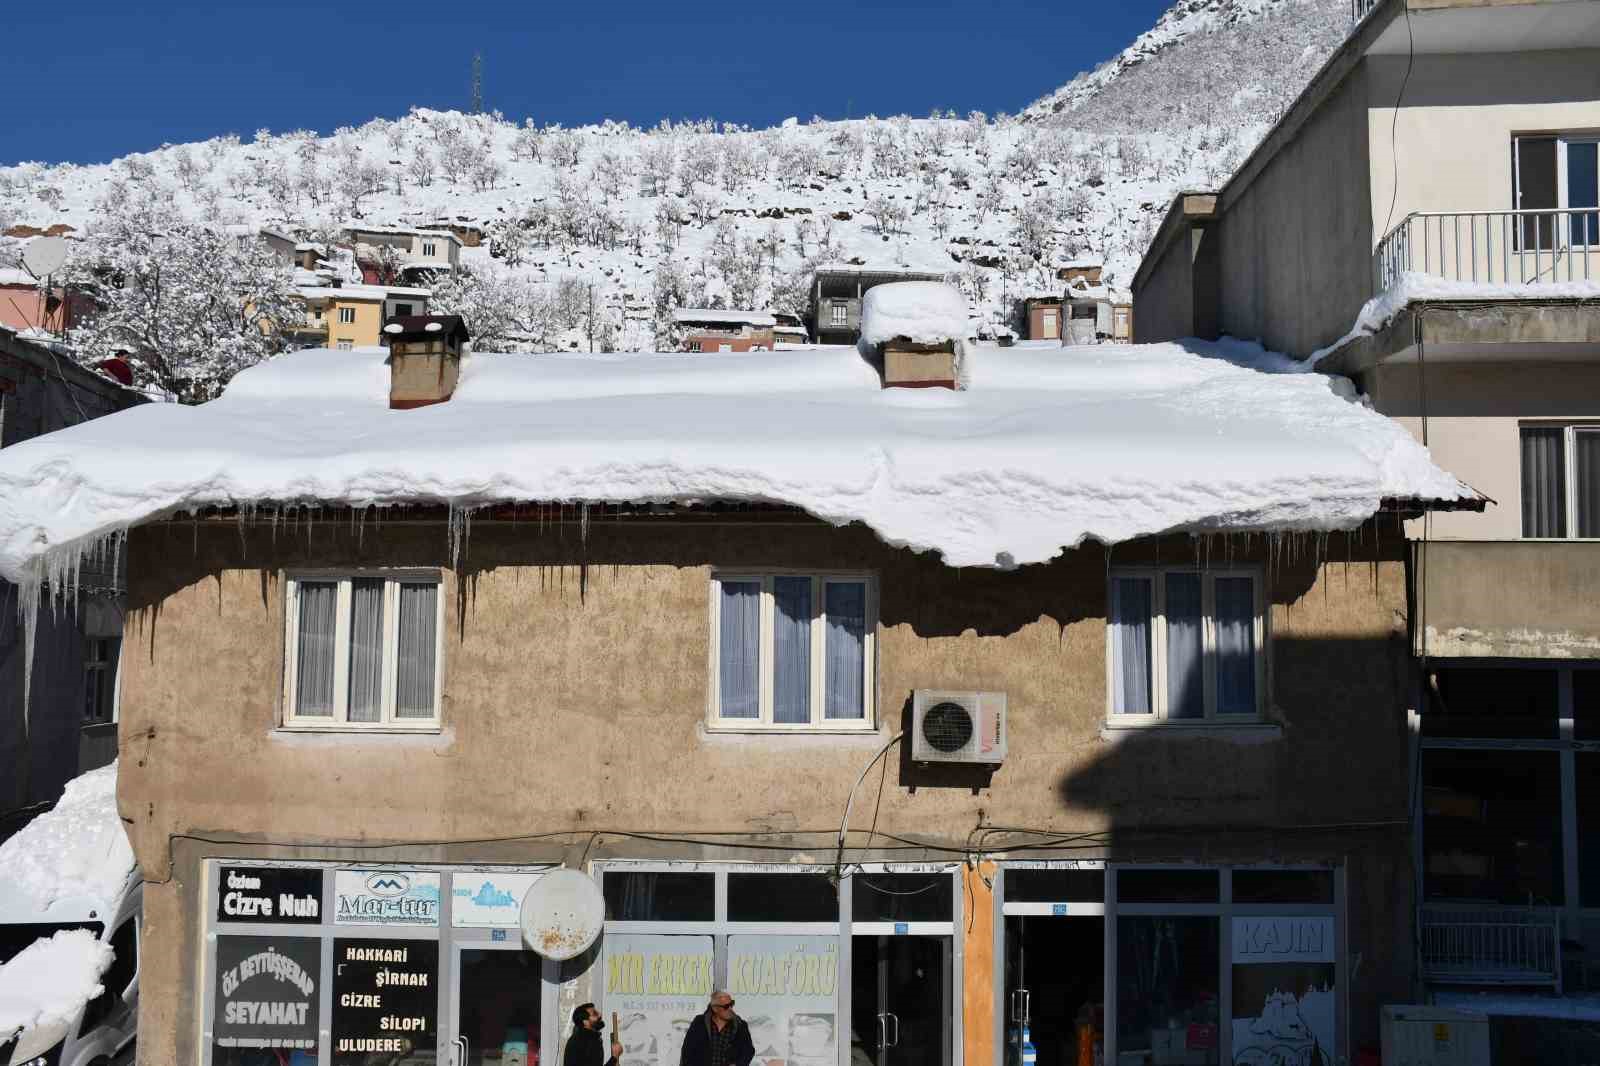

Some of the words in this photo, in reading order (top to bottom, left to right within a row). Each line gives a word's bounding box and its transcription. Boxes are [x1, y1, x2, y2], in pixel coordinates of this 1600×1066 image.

[224, 892, 273, 916] Cizre
[280, 893, 319, 917] Nuh
[338, 894, 437, 915] Mar-tur
[346, 947, 408, 963] HAKKARİ
[223, 967, 239, 997] ÖZ
[341, 992, 382, 1009] CİZRE
[225, 1001, 309, 1025] SEYAHAT
[339, 1038, 401, 1053] ULUDERE
